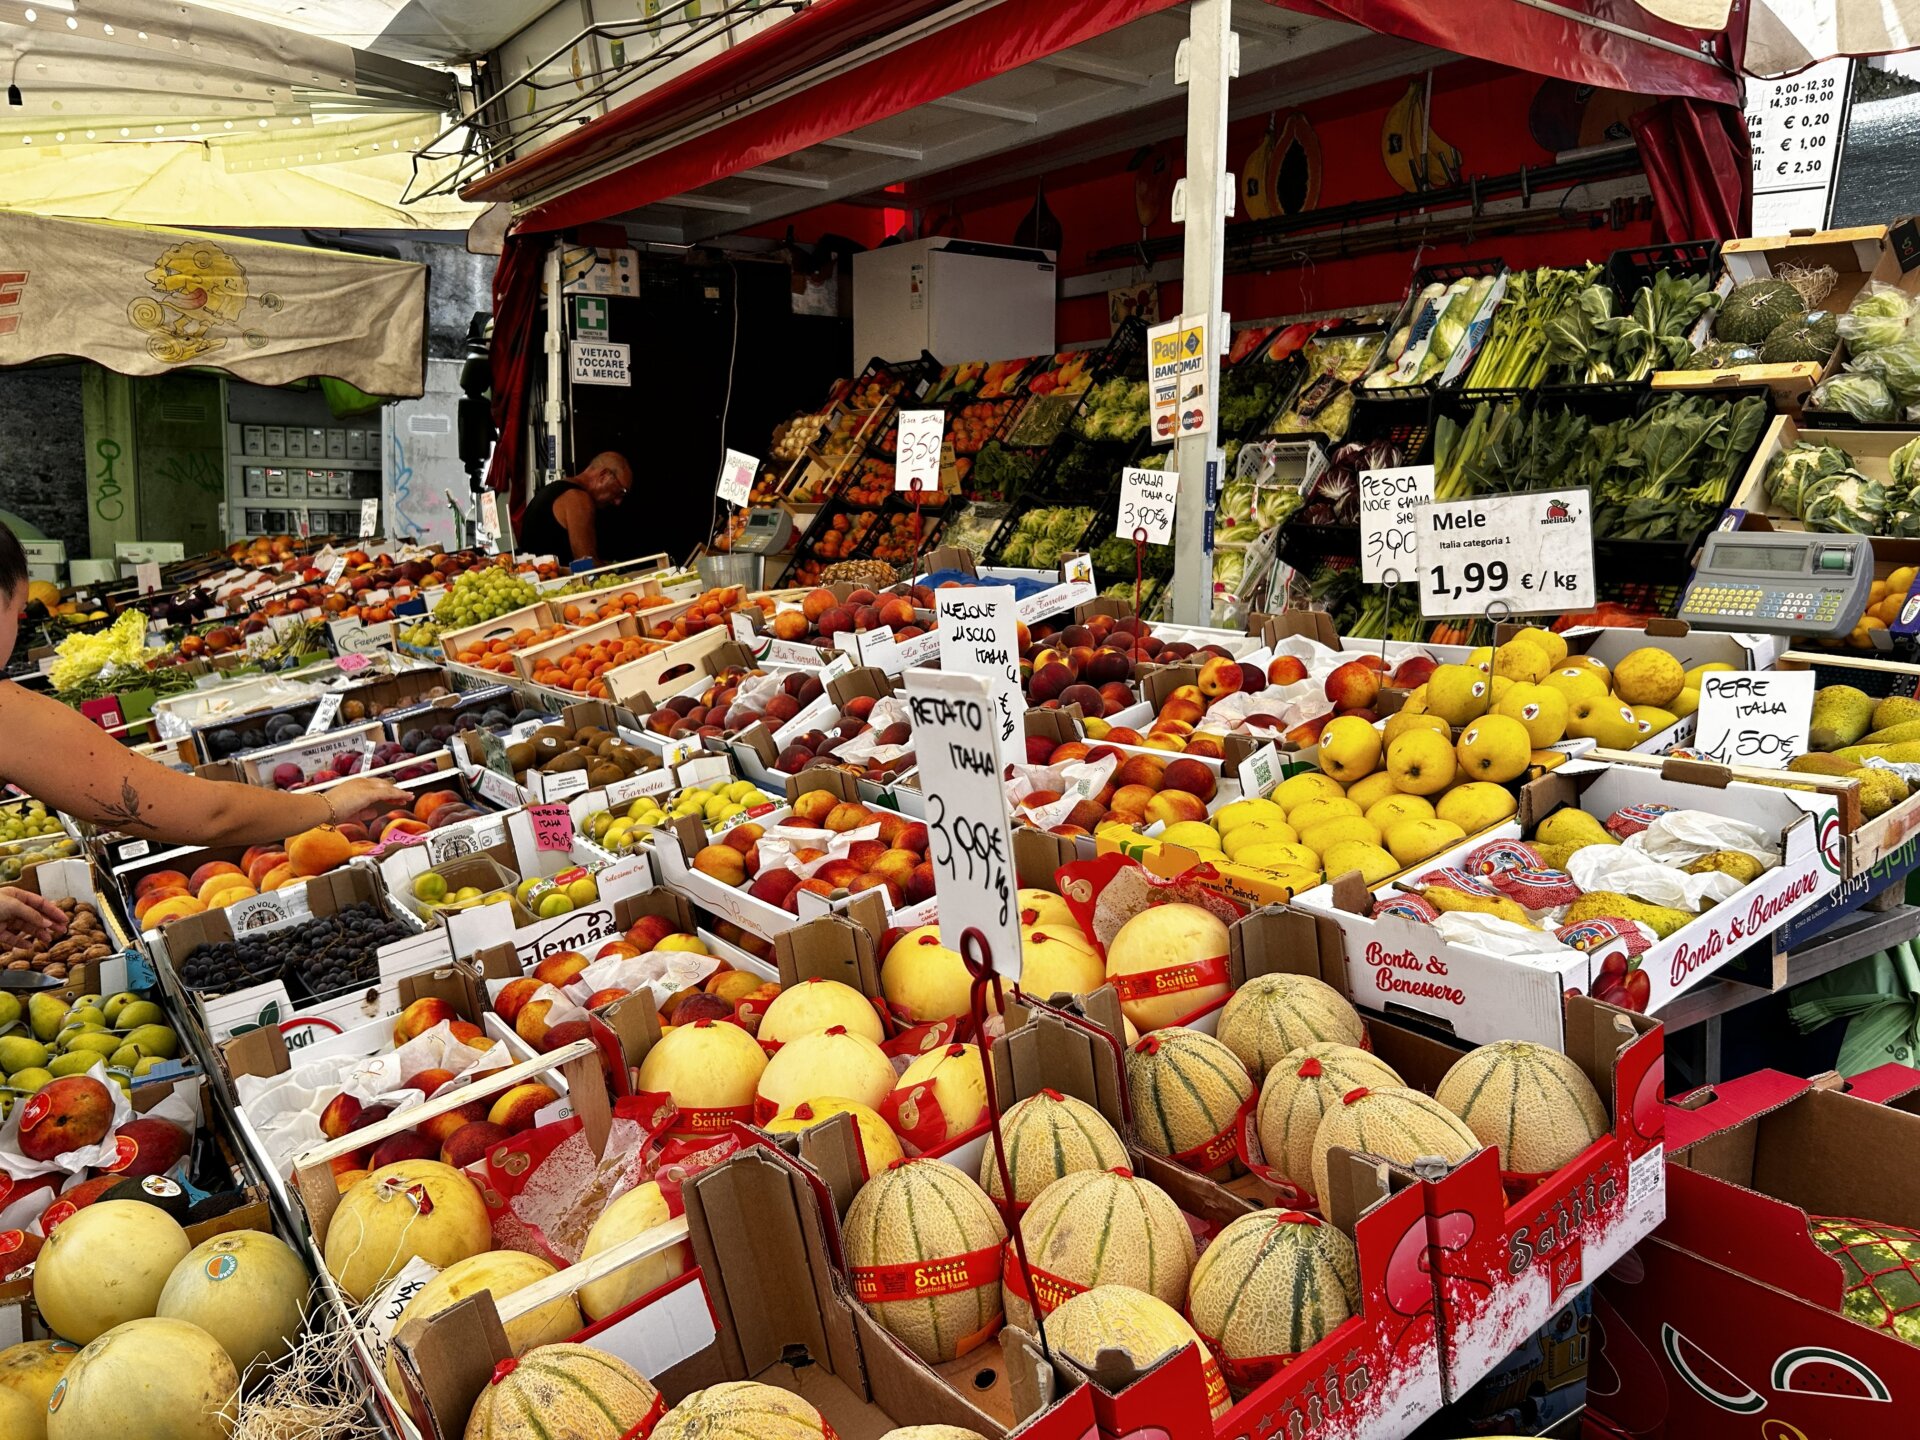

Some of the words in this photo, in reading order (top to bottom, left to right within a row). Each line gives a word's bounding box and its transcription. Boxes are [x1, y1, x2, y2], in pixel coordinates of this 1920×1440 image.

[1784, 115, 1795, 129] €
[1780, 138, 1792, 151] €
[1777, 161, 1788, 175] €
[580, 347, 621, 359] VIETATO
[578, 357, 624, 368] TOCCARE
[1155, 357, 1202, 378] BANCOMAT
[576, 368, 588, 377] LA
[593, 369, 626, 379] MERCE
[1159, 391, 1175, 401] VISA
[1362, 475, 1417, 498] PESCA
[1363, 498, 1391, 512] NOCE
[1433, 510, 1486, 531] Mele
[1541, 514, 1577, 525] melitaly
[1439, 540, 1461, 550] Italia
[1463, 537, 1504, 550] categoria
[1505, 536, 1511, 545] 1
[1430, 560, 1510, 601] 1,99
[1521, 573, 1533, 590] €
[1538, 570, 1548, 592] /
[1554, 571, 1577, 591] kg
[940, 602, 998, 621] MELONE
[952, 626, 996, 643] LISCIO
[901, 646, 918, 659] La
[976, 647, 1009, 665] ITALIA
[1706, 677, 1770, 699] PERE
[909, 695, 982, 732] RETATO
[1736, 702, 1787, 719] ITALIA
[949, 741, 995, 778] ITALIA
[618, 781, 665, 799] Torretta
[1225, 883, 1259, 902] Melinda
[248, 904, 257, 913] DI
[256, 901, 288, 921] VOLPEDO
[1669, 928, 1725, 988] Bontà
[1726, 914, 1746, 946] &
[1746, 869, 1819, 937] Benessere
[1365, 941, 1424, 972] Bontà
[1425, 954, 1448, 976] &
[1155, 974, 1198, 989] Sattin
[1375, 966, 1466, 1006] Benessere
[691, 1112, 734, 1128] Sattin
[1507, 1178, 1616, 1276] Sattin
[915, 1267, 969, 1288] Sattin
